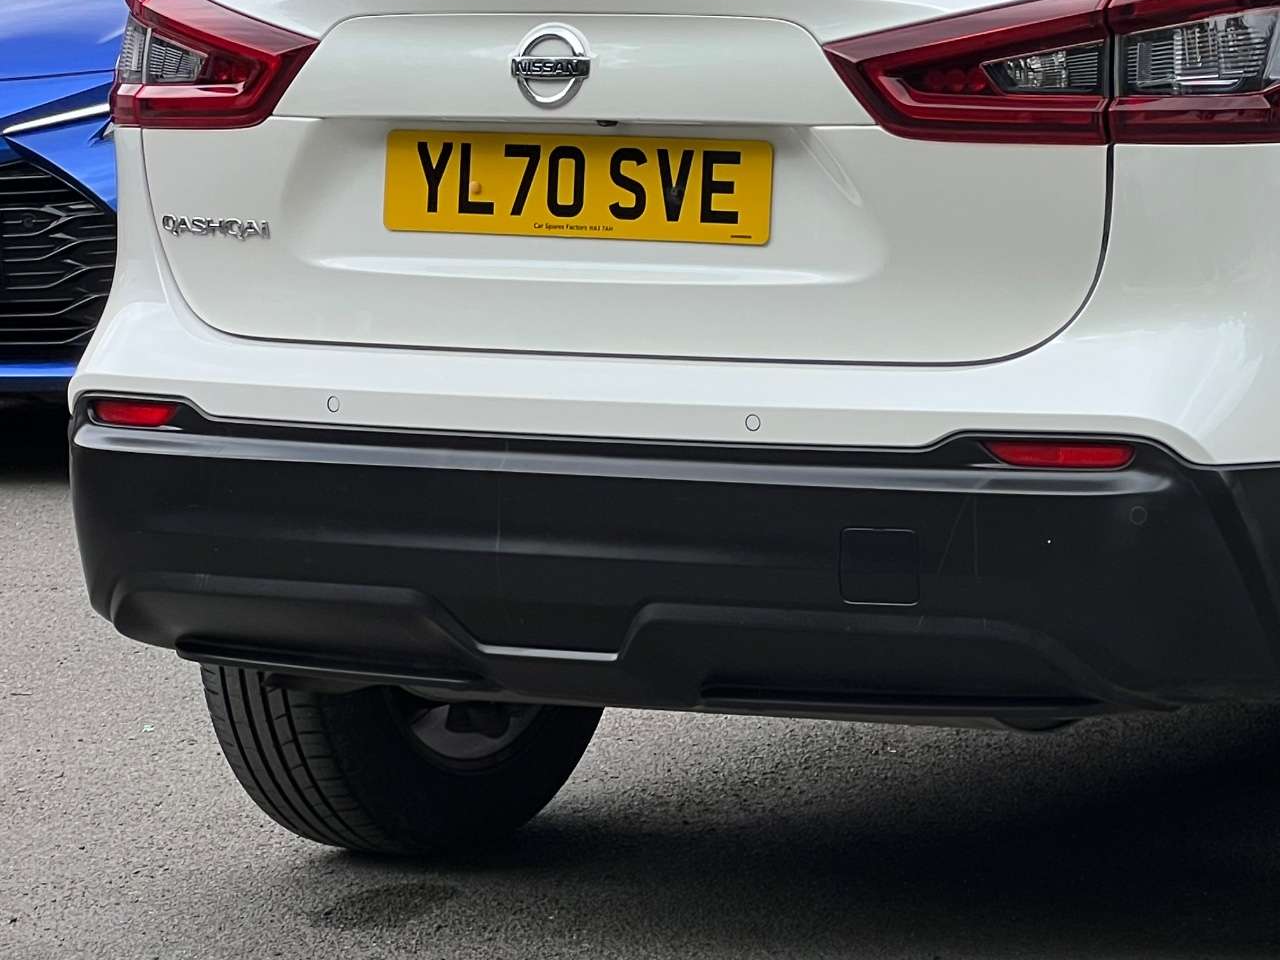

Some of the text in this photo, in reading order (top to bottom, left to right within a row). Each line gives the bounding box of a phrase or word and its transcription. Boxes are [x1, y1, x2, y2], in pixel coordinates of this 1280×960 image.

[517, 59, 579, 75] NISSAN
[416, 141, 742, 225] YL70 SVE
[161, 213, 271, 241] QASHQAI
